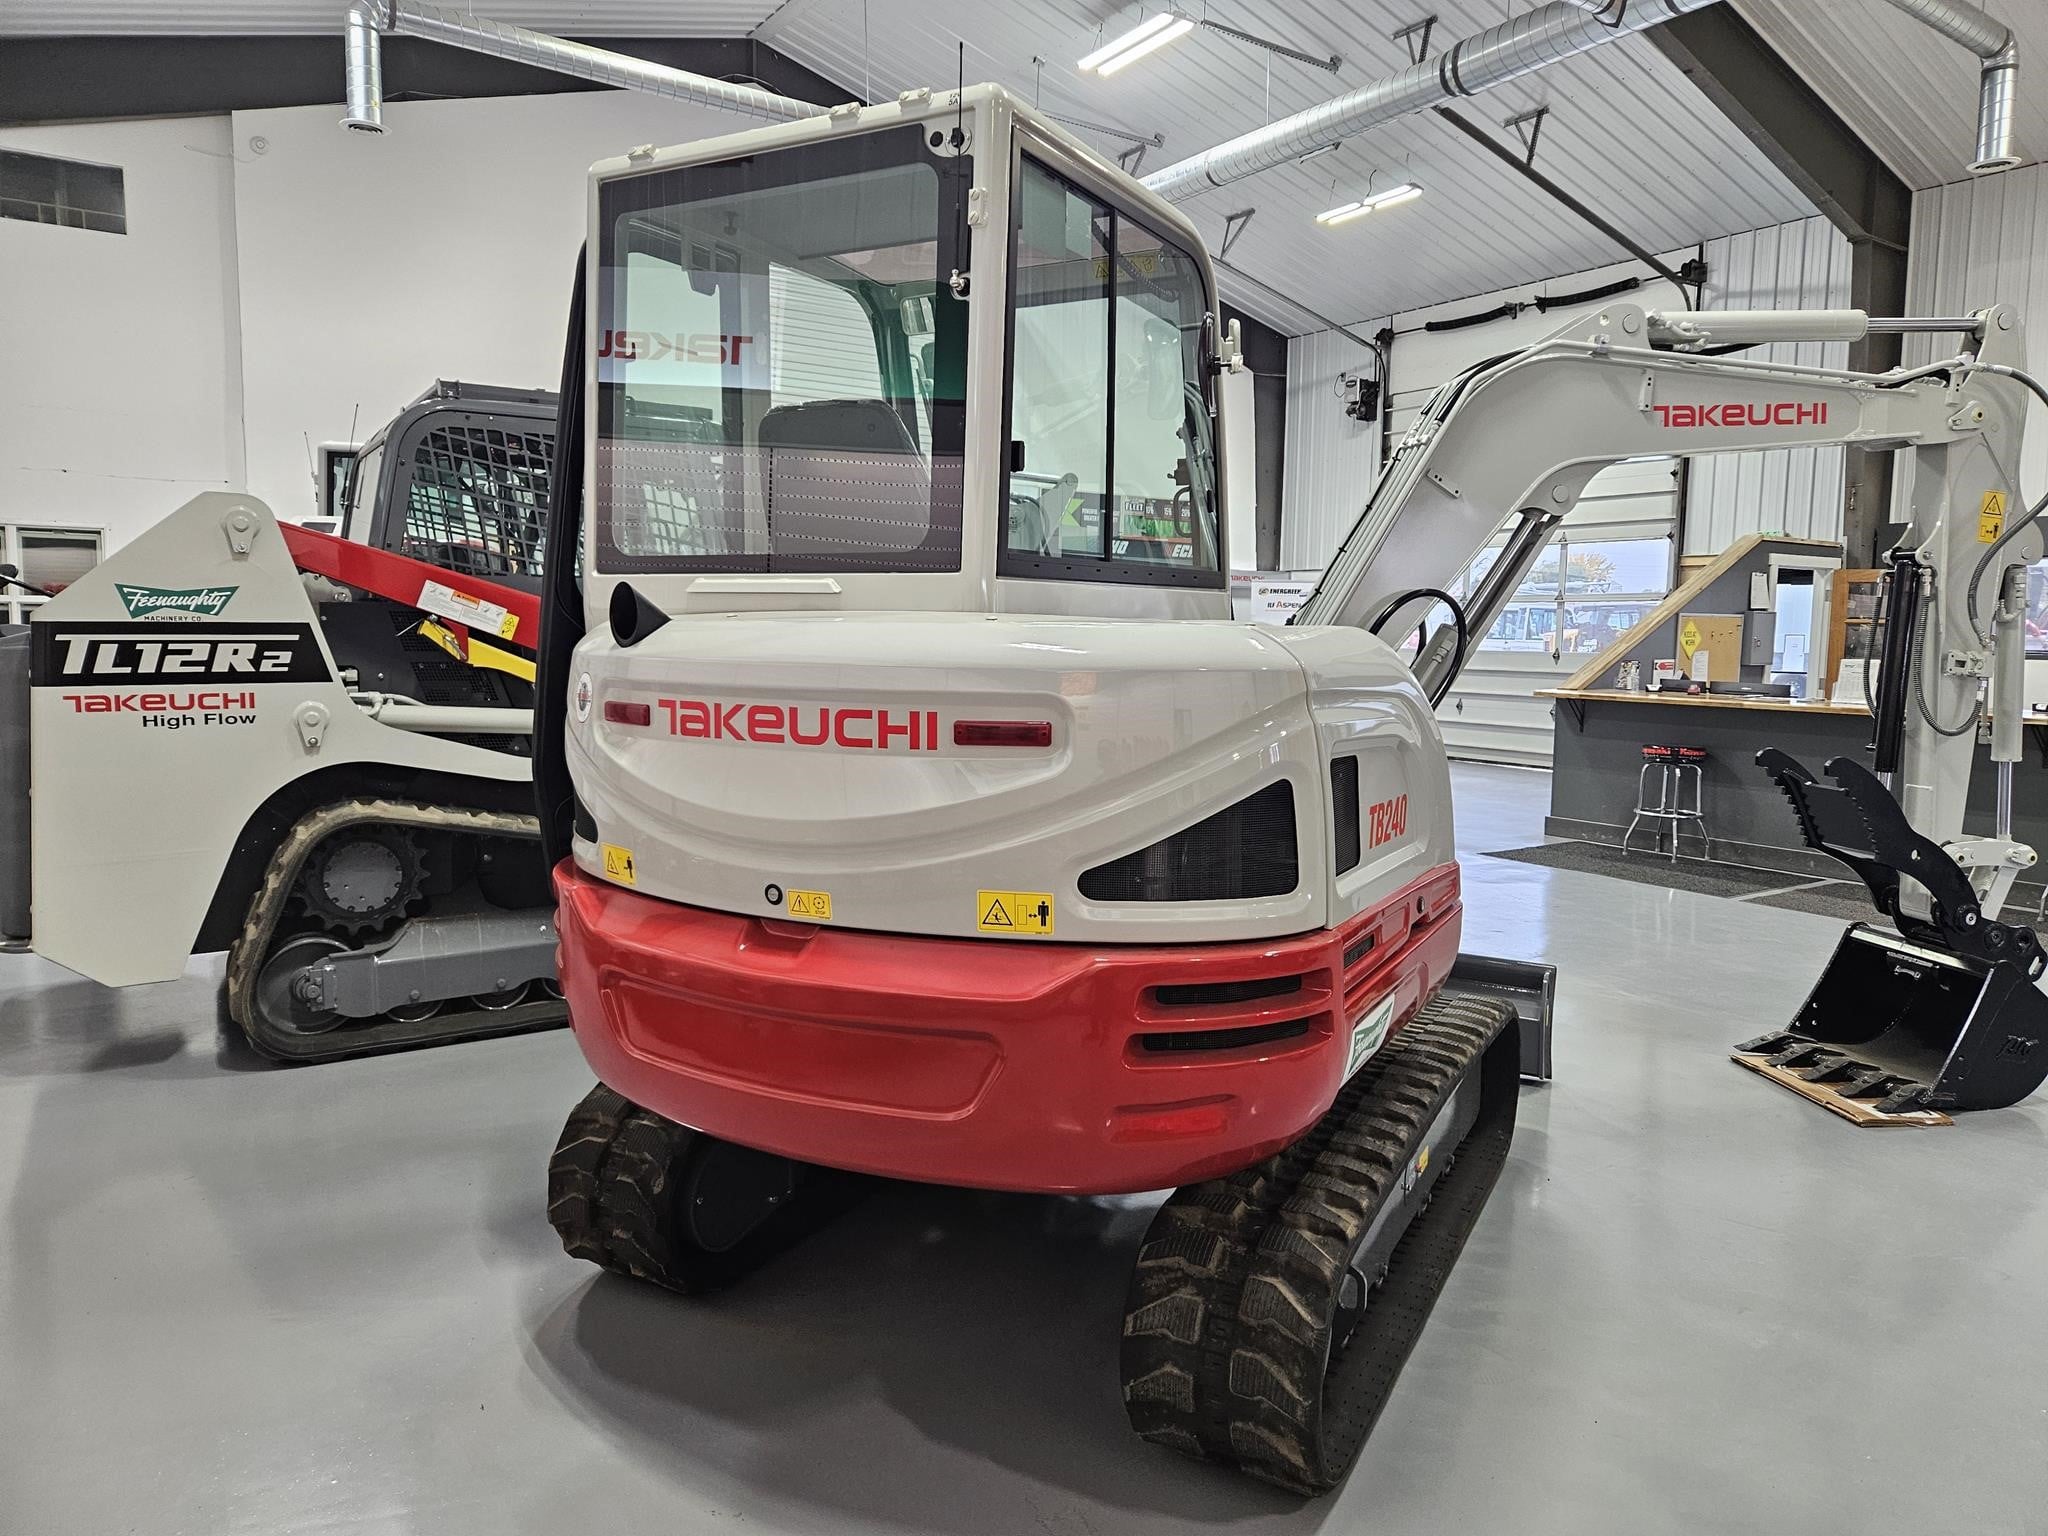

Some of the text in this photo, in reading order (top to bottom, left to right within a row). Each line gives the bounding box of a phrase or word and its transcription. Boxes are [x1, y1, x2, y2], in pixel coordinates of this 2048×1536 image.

[1653, 402, 1827, 428] TAKEUCHI
[122, 587, 232, 614] Feenaughty
[55, 634, 300, 674] TL12R2
[62, 692, 255, 713] TAKEUCHI
[142, 713, 256, 729] High Flow
[658, 699, 938, 750] TAKEUCHI
[1368, 793, 1408, 850] TB240
